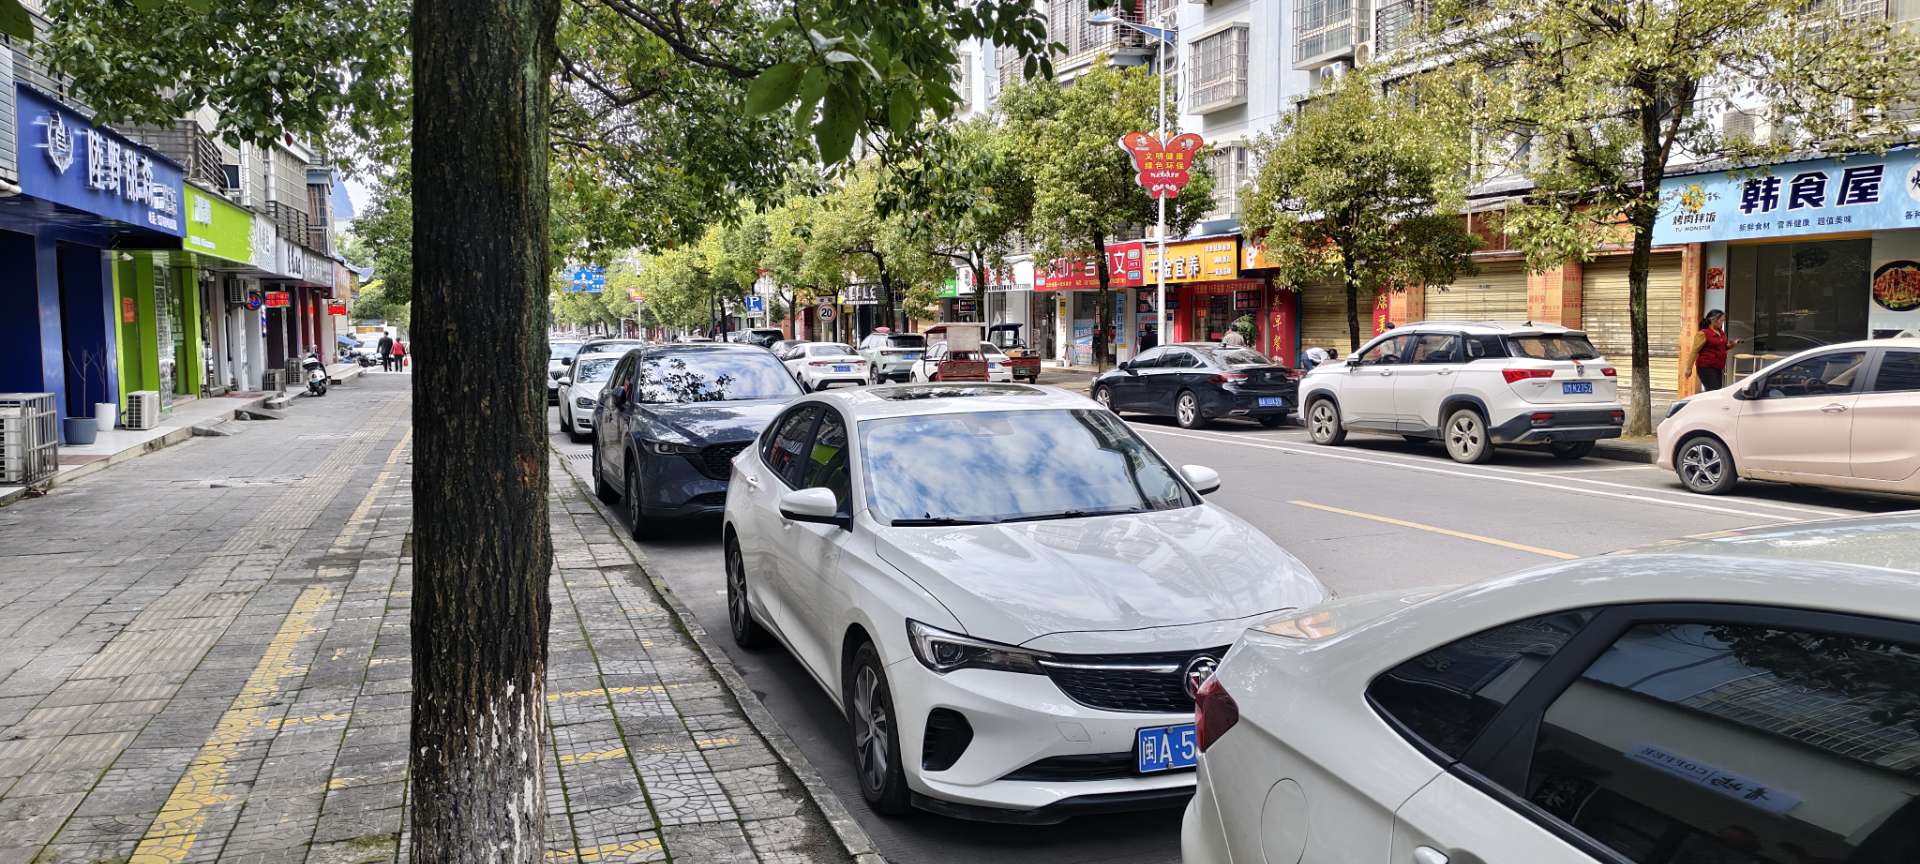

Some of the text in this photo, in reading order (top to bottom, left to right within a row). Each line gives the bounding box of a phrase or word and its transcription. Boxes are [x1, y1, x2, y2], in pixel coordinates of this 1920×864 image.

[1740, 164, 1885, 215] 韩食屋
[1738, 215, 1852, 233] 新鲜食材 营养健康 超值美味
[821, 307, 832, 318] 20
